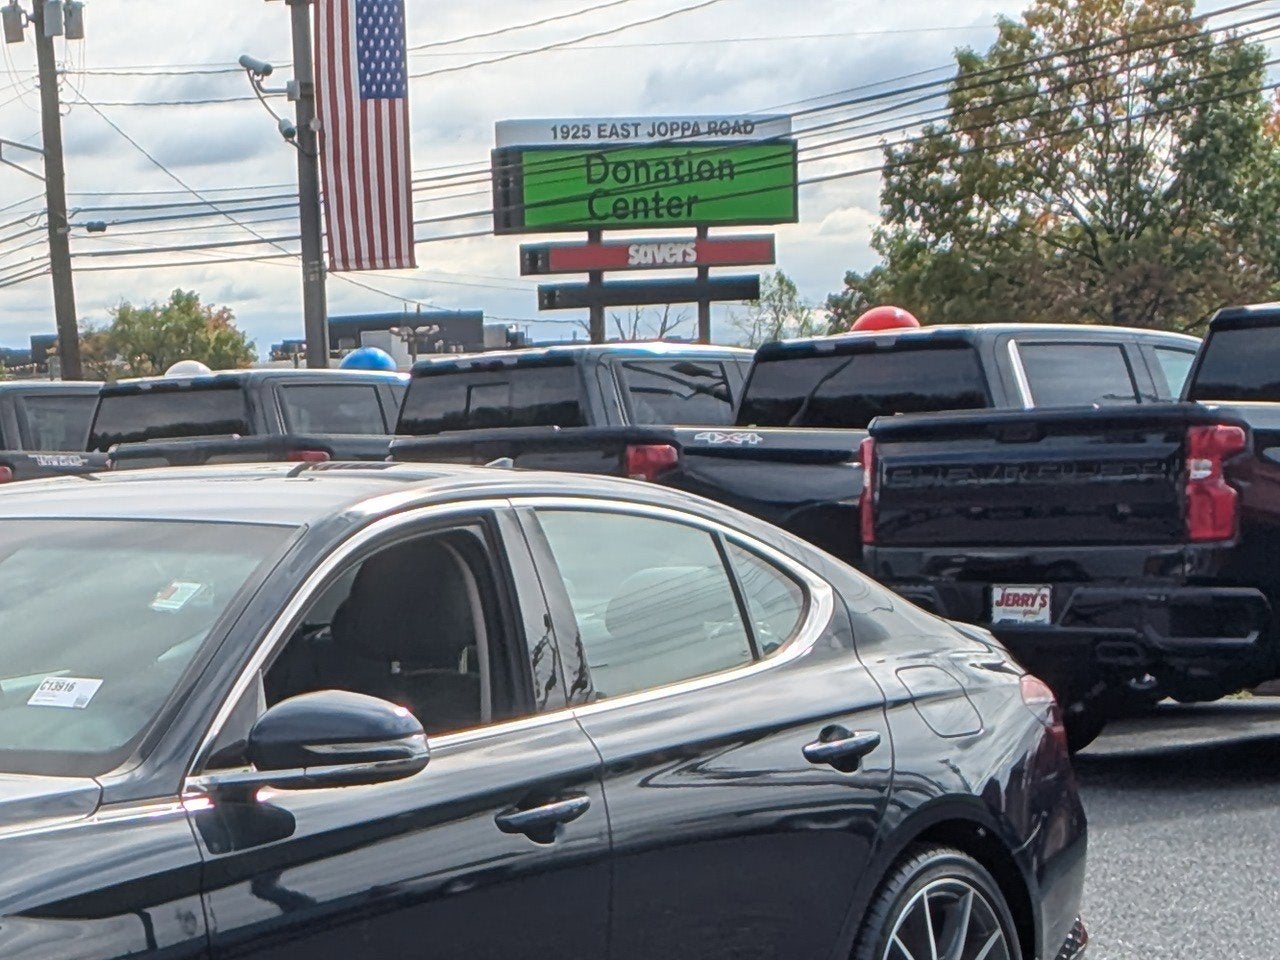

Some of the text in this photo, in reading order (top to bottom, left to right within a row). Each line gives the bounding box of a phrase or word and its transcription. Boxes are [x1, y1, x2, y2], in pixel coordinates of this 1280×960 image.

[551, 119, 755, 140] 1925 EAST JOPPA ROAD
[586, 151, 735, 185] Donation
[587, 189, 699, 221] Center
[995, 592, 1048, 608] JERRY'S
